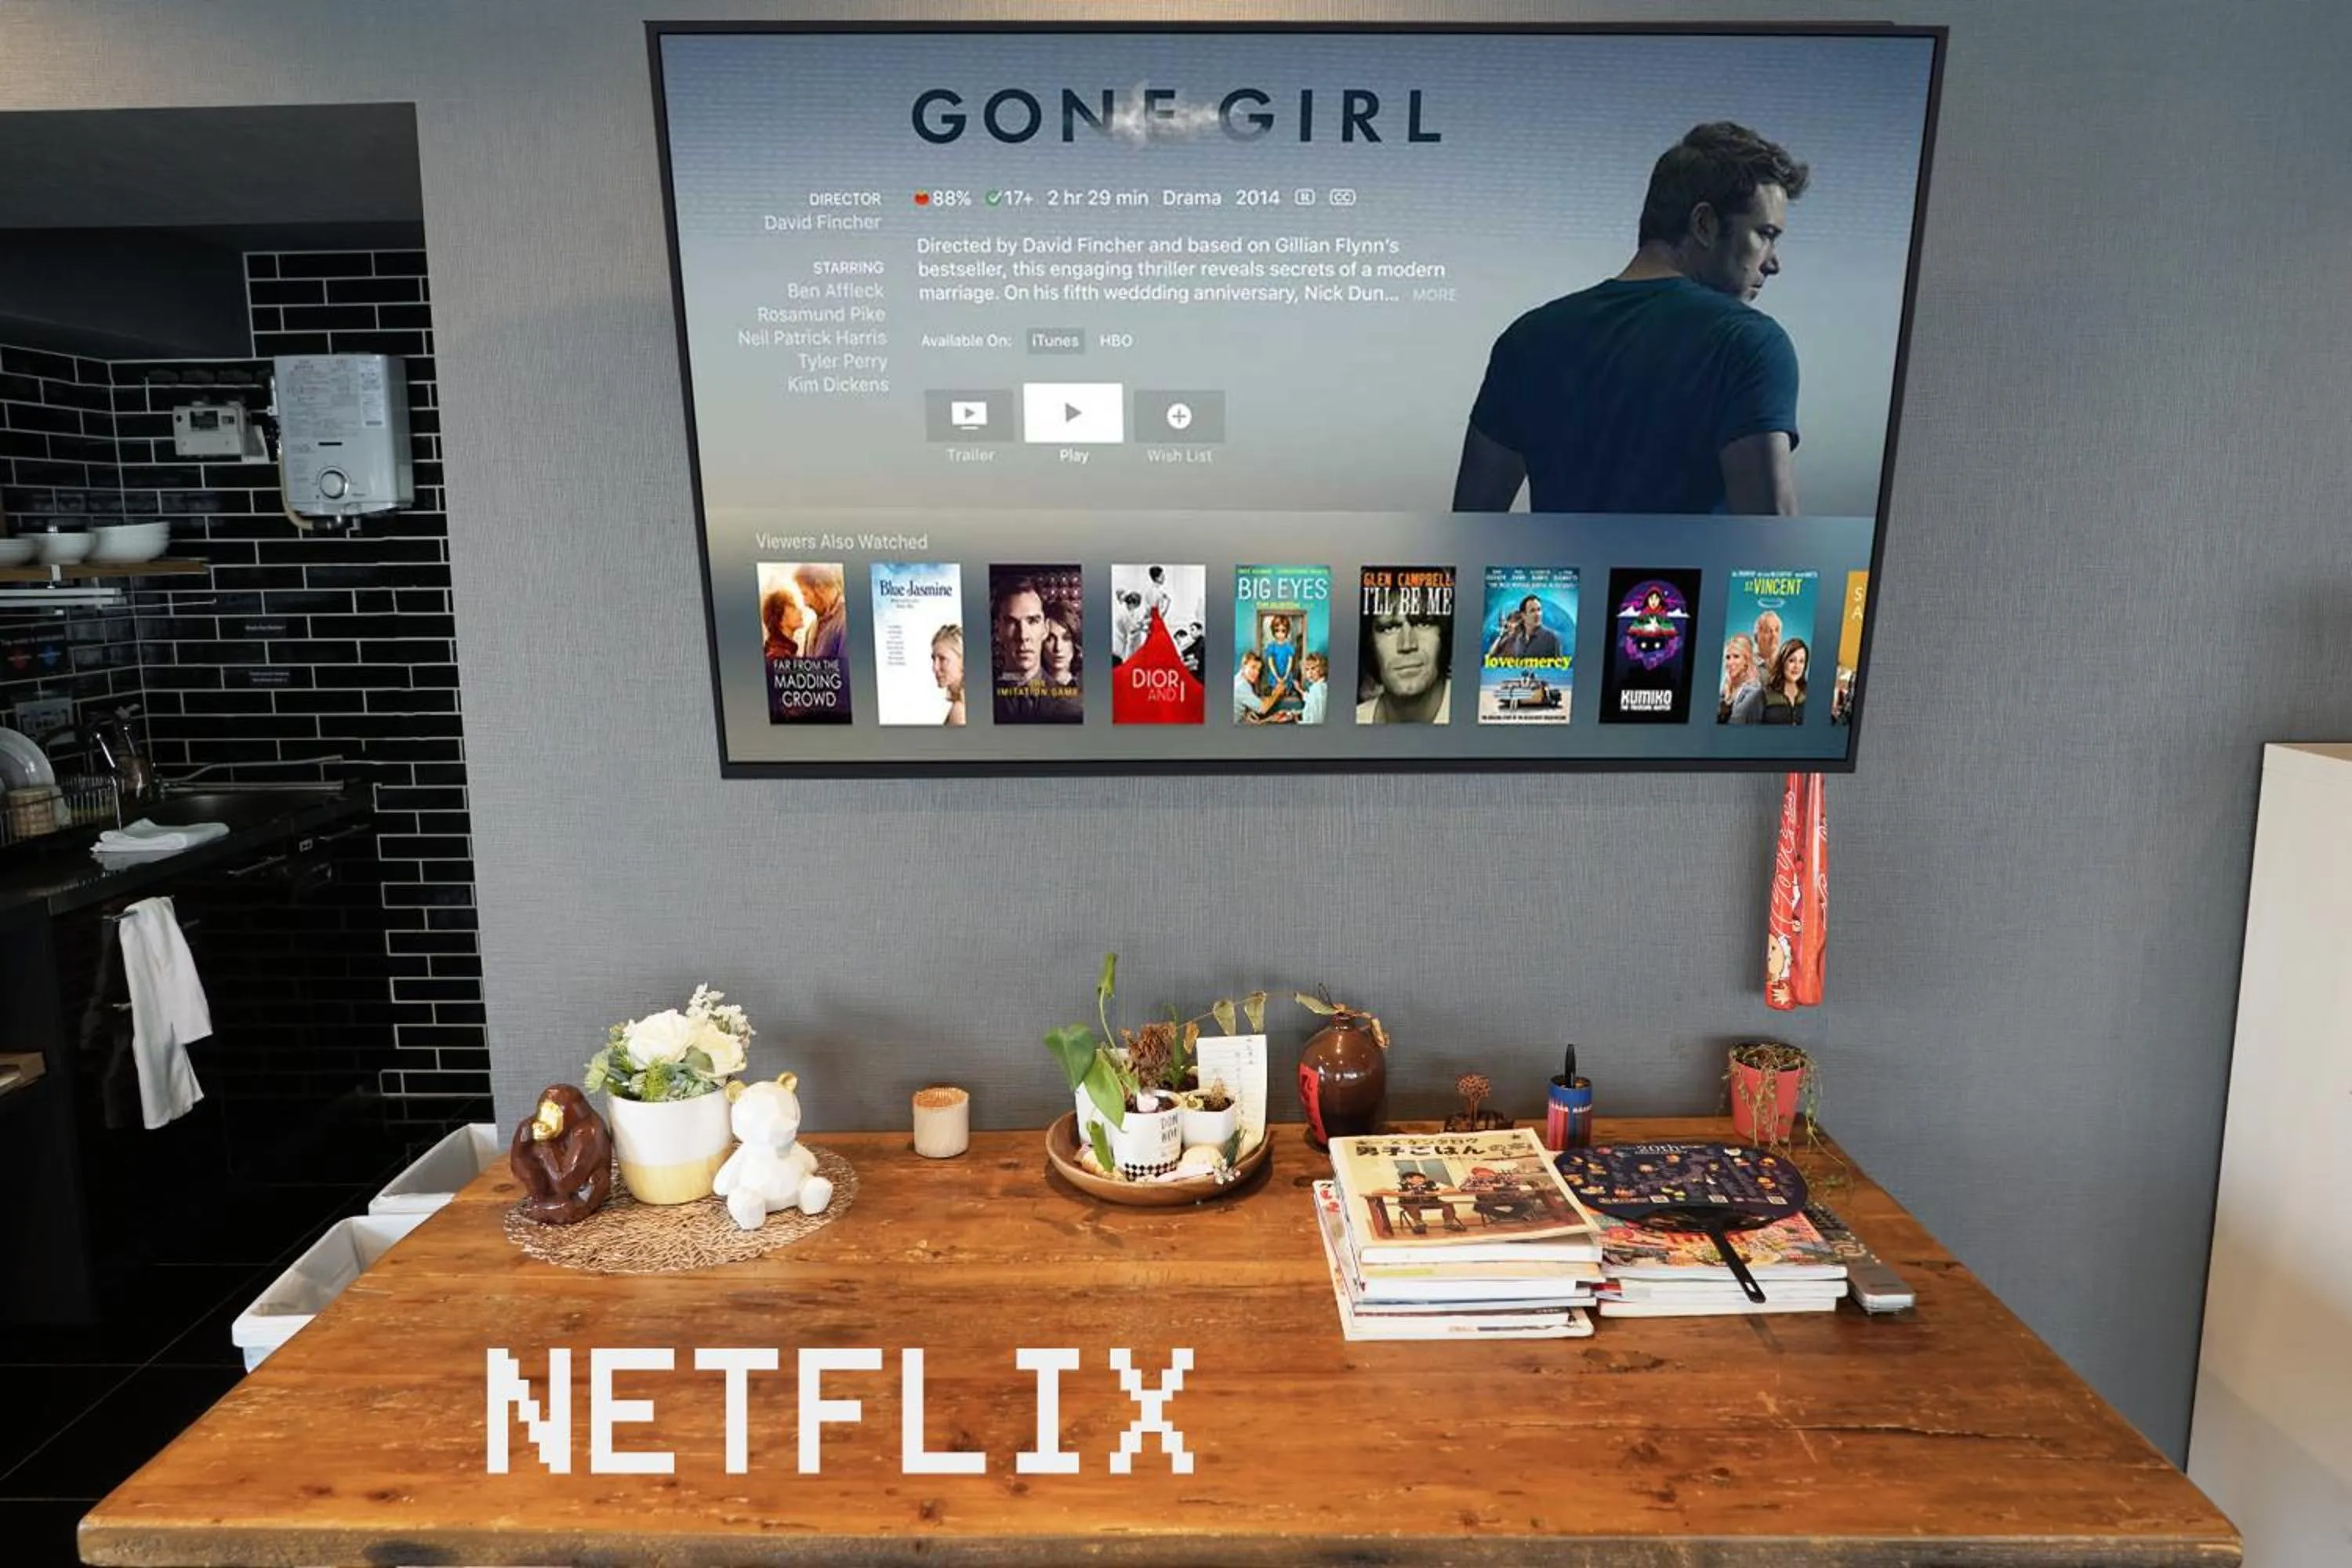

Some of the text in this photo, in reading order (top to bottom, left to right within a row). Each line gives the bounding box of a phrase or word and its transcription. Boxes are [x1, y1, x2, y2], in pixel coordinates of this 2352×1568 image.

[912, 88, 1442, 144] GONE GIRL
[809, 192, 882, 206] DIRECTOR
[932, 189, 972, 207] 88%
[1003, 191, 1034, 206] 17+
[1047, 190, 1059, 205] 2
[1063, 189, 1081, 205] hr
[1087, 189, 1111, 205] 29
[1116, 190, 1149, 205] min
[1163, 189, 1221, 205] Drama
[1236, 189, 1280, 205] 2014
[764, 214, 882, 230] David Fincher
[916, 238, 1399, 256] Directed by David Fincher and based on Gillian Flynn's
[813, 261, 885, 274] STARRING
[918, 260, 1446, 280] bestseller, this engaging thriller reveals secrets of a modern
[787, 282, 884, 299] Ben Affleck
[919, 285, 999, 303] marriage.
[1004, 285, 1029, 300] On
[1033, 285, 1059, 300] his
[1064, 285, 1098, 300] fifth
[1193, 285, 1299, 304] anniversary,
[1305, 285, 1343, 301] Nick
[1414, 289, 1457, 303] MORE
[757, 307, 886, 322] Rosamund Pike
[738, 330, 887, 346] Neil Patrick Harris
[922, 334, 1012, 347] Available On:
[1032, 333, 1080, 347] iTunes
[1100, 334, 1133, 347] HBO
[798, 353, 888, 372] Tyler Perry
[788, 376, 890, 393] Kim Dickens
[947, 449, 996, 462] Trailer
[1059, 449, 1089, 464] Play
[1147, 449, 1212, 463] Wish List
[756, 533, 928, 550] Viewers Also Watched
[1363, 572, 1392, 587] GLEN
[1754, 578, 1802, 596] VINCENT
[880, 579, 953, 597] Blue Jasmine
[1238, 577, 1328, 601] BIG EYES
[1363, 586, 1453, 616] I'LL BE ME
[774, 659, 790, 671] FAR
[793, 659, 821, 670] FROM
[774, 673, 842, 689] MADDING
[1132, 669, 1179, 688] DIOR
[782, 691, 837, 707] CROWD
[1148, 689, 1176, 702] AND
[1621, 689, 1673, 705] KUMIKO
